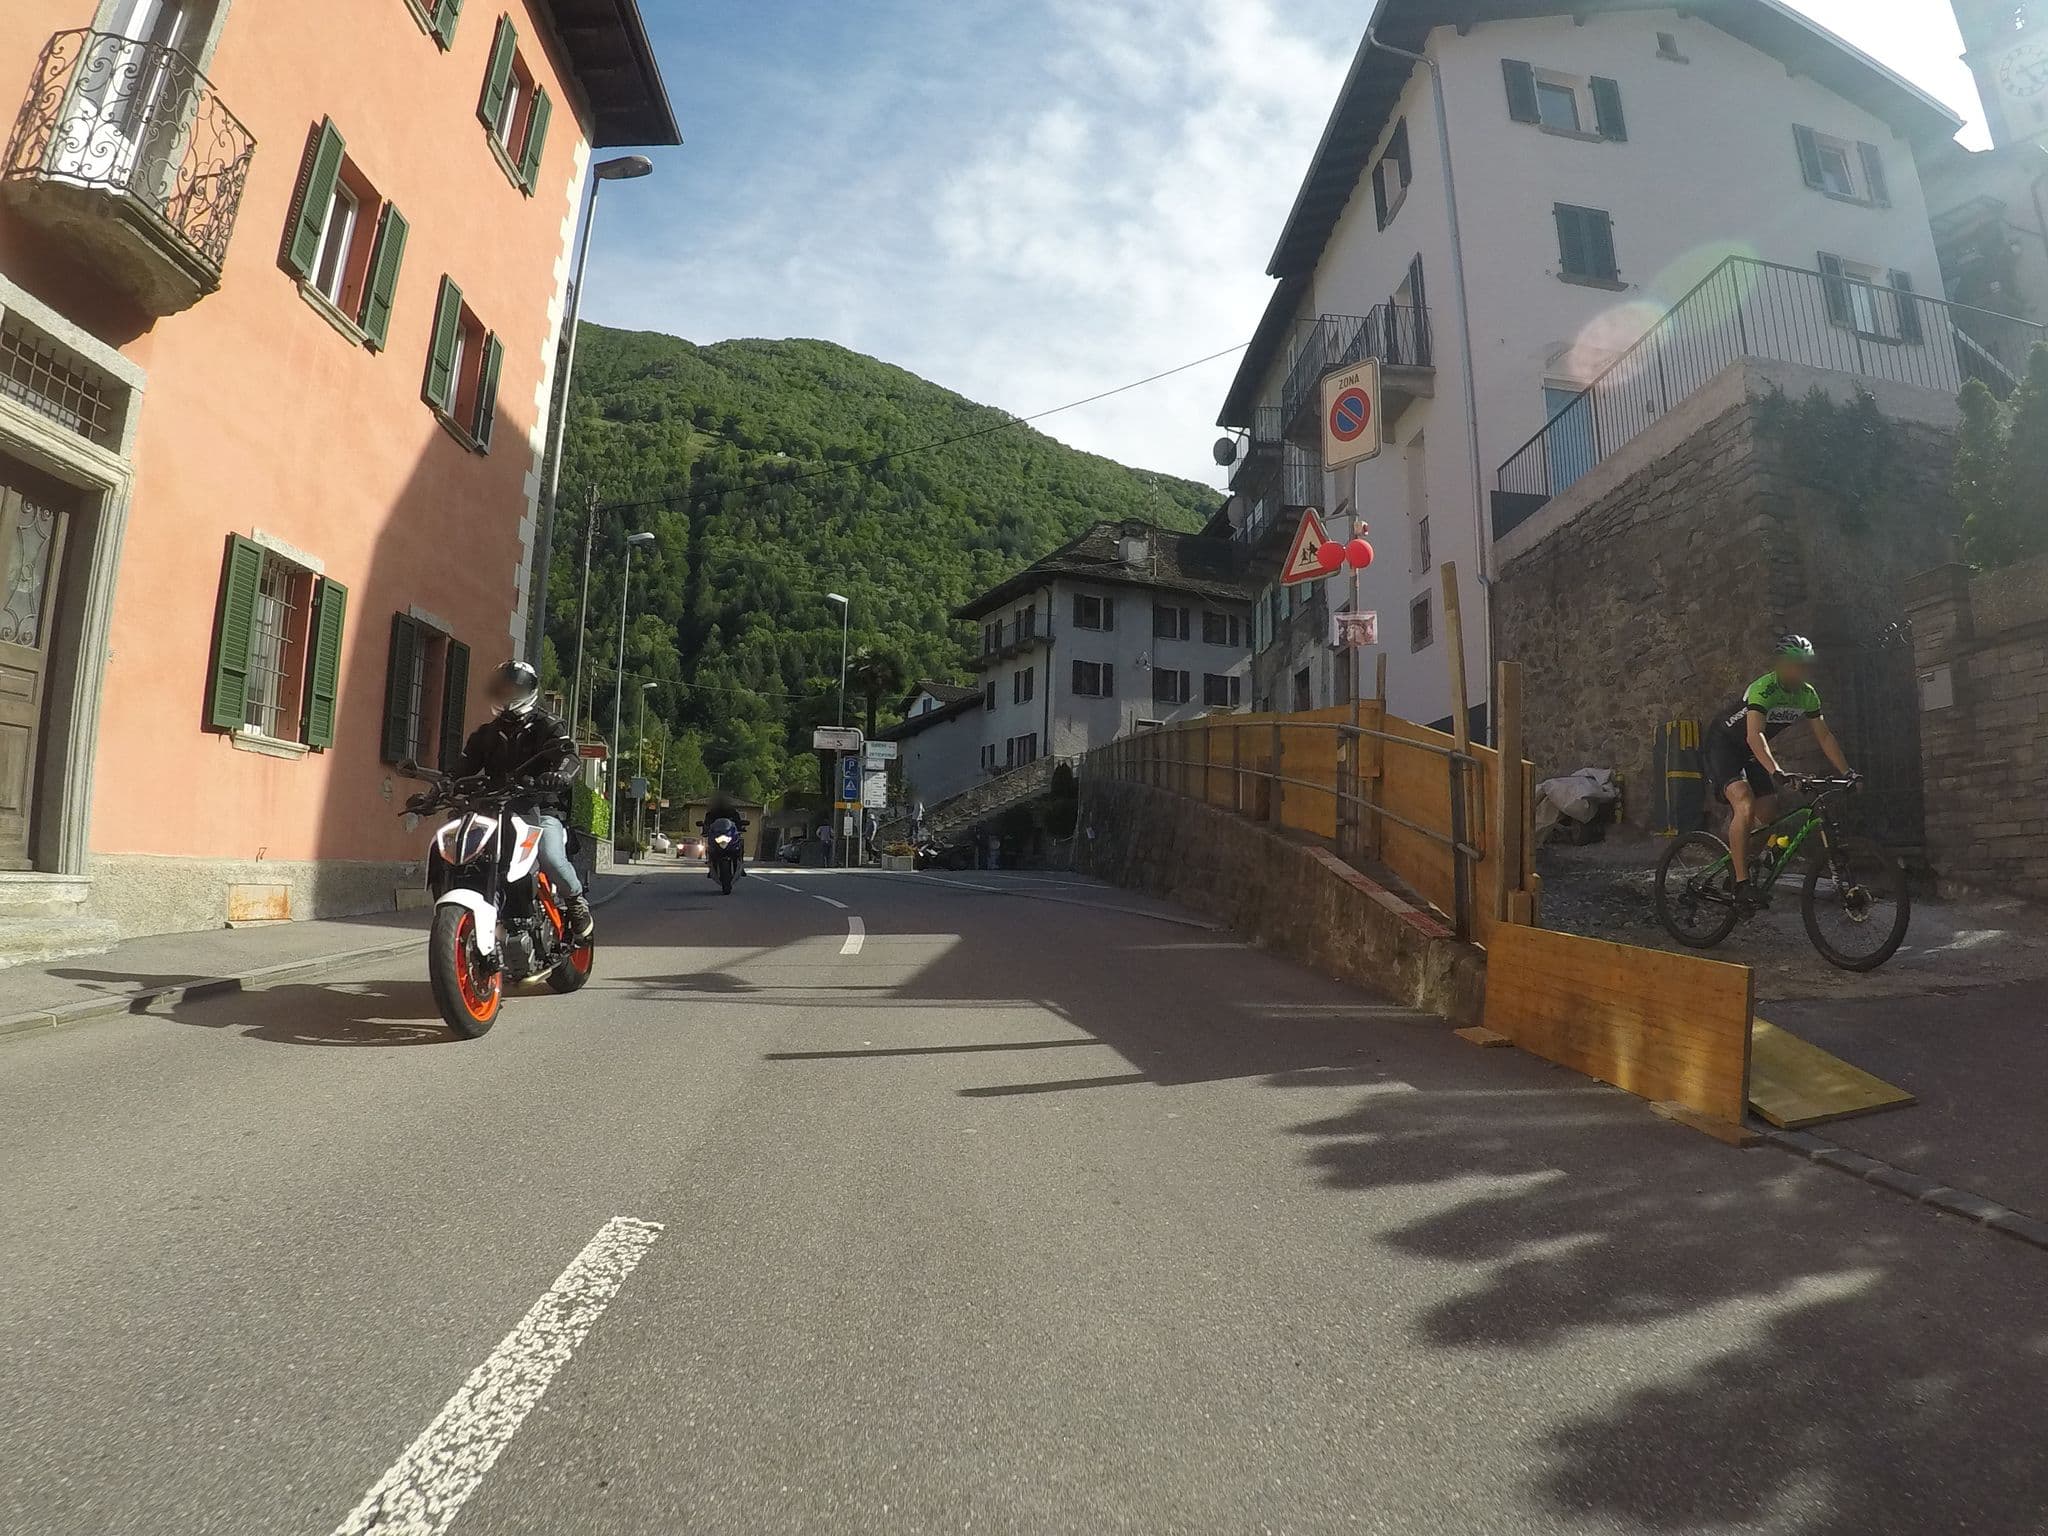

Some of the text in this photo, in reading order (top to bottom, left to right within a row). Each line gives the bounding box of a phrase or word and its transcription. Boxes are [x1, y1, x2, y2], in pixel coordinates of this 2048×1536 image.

[1339, 374, 1360, 390] ZONA
[1768, 710, 1799, 721] belkin
[848, 761, 855, 769] P
